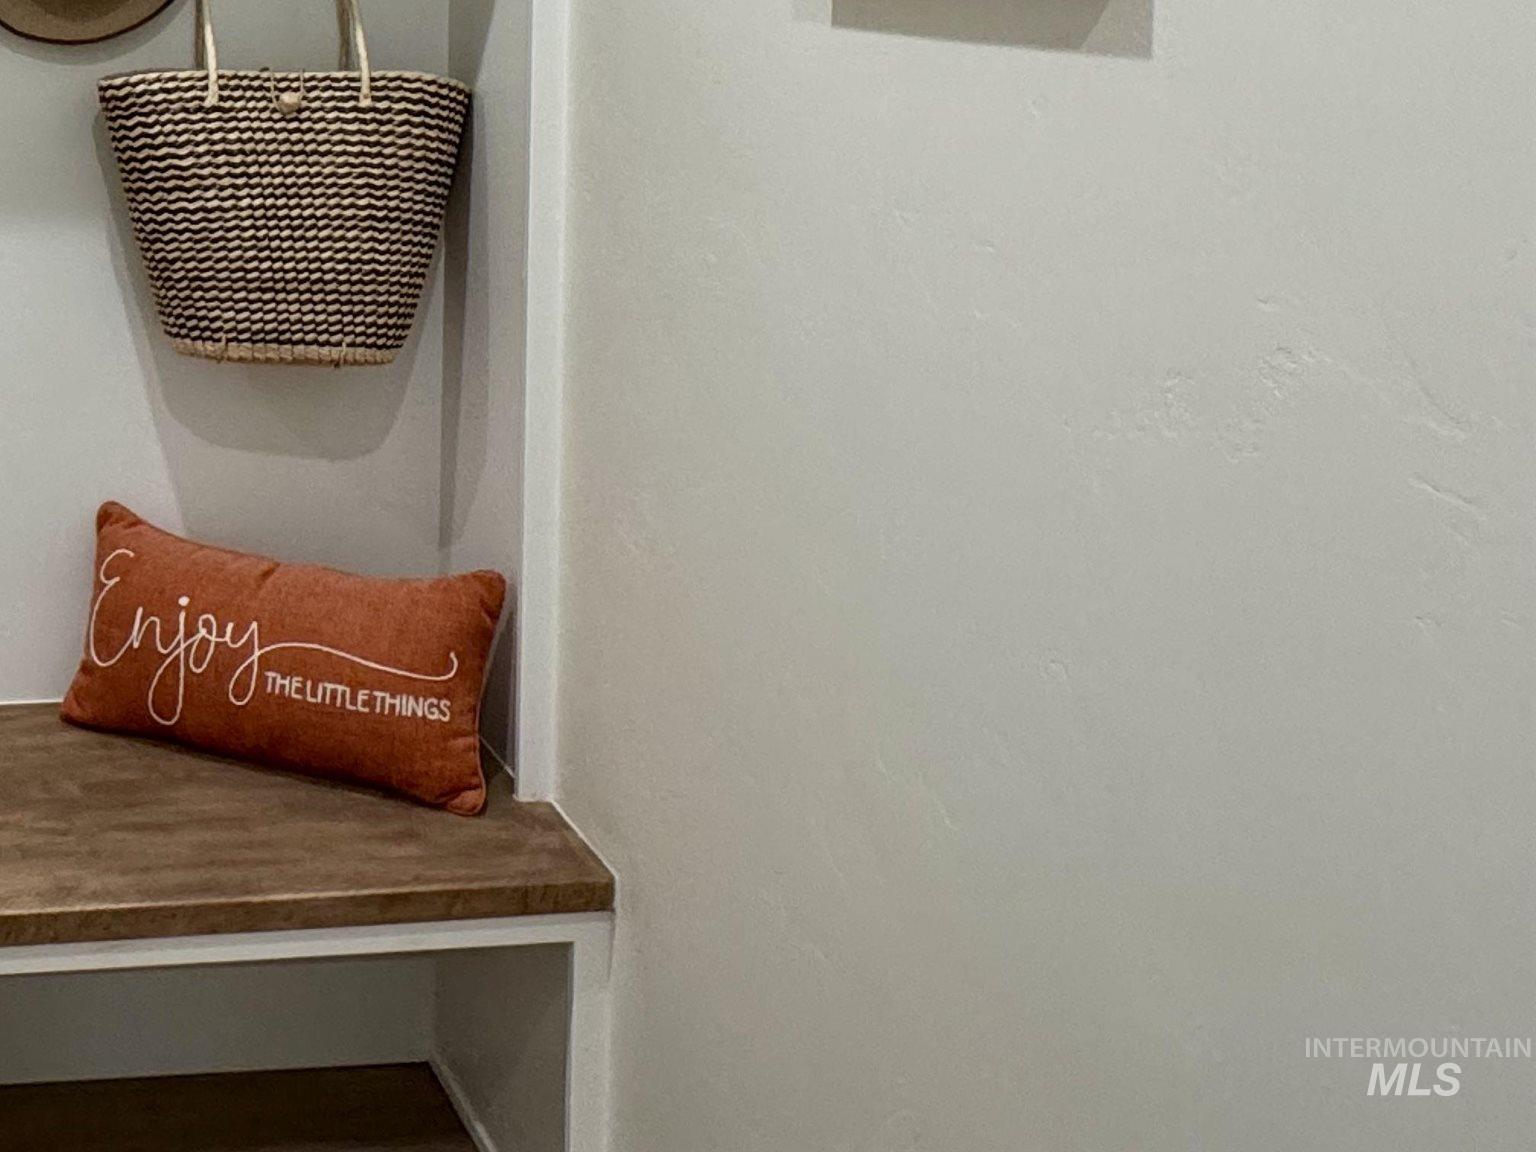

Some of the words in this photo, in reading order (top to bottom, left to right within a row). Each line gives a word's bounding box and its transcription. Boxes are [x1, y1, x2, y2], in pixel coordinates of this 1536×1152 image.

[264, 671, 303, 699] THE
[306, 679, 370, 712] LITTLE
[372, 690, 451, 723] THINGS
